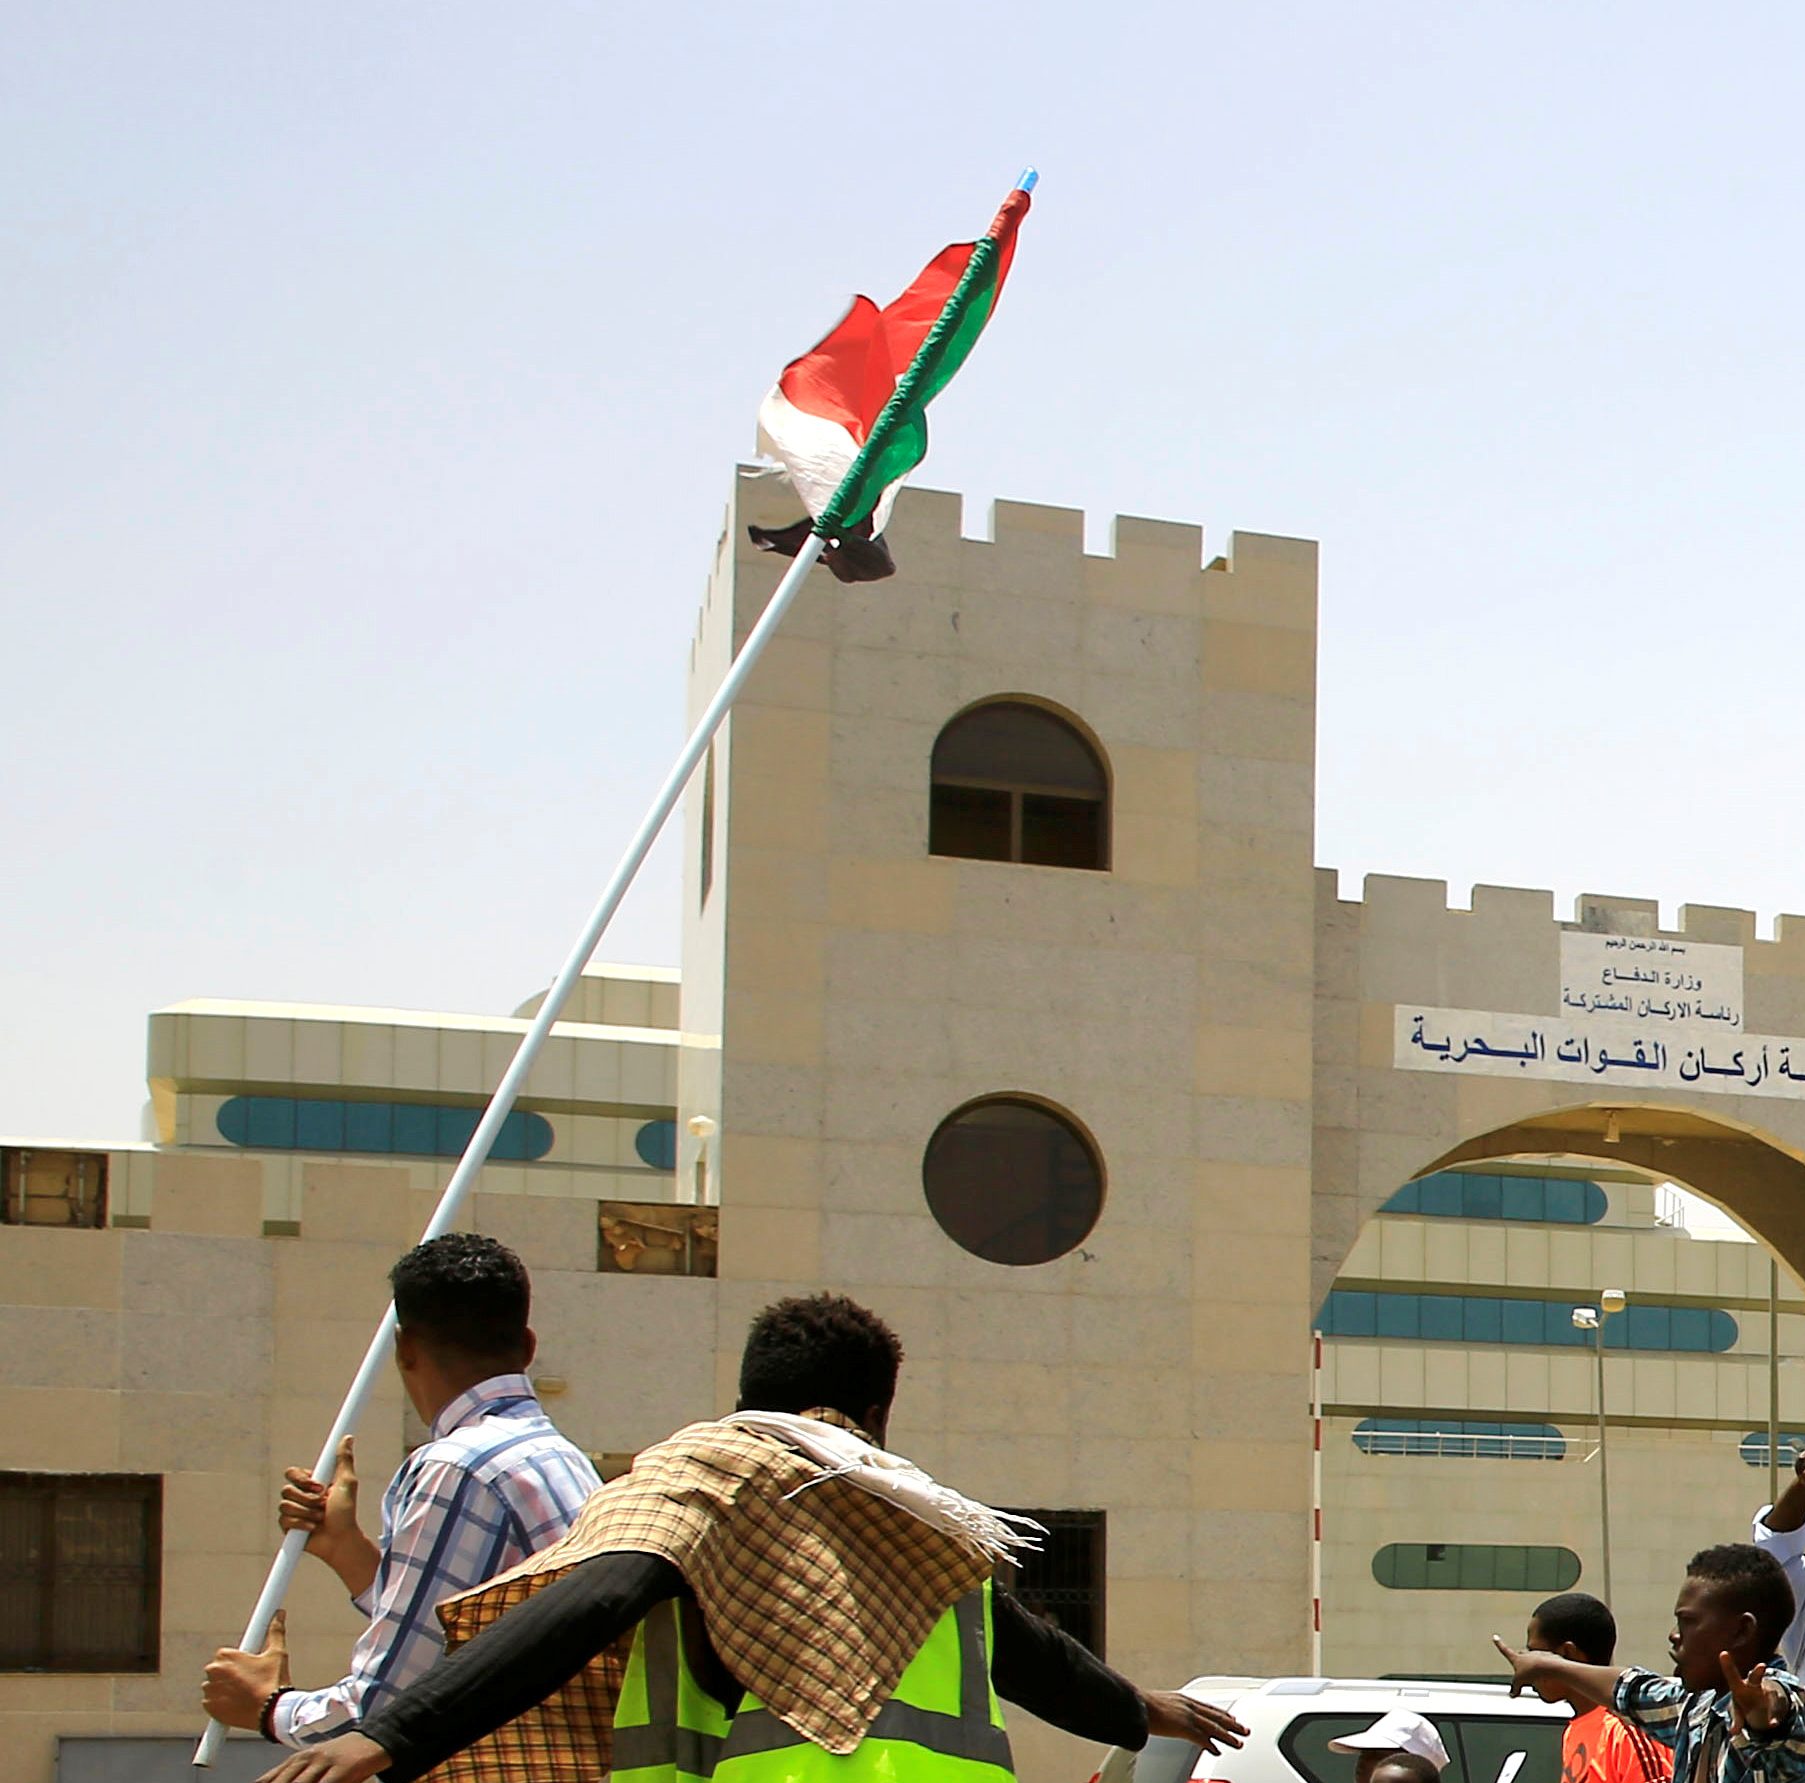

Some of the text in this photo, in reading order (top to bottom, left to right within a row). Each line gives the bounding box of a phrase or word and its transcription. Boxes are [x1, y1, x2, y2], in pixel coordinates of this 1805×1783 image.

[1658, 940, 1670, 951] الله
[1671, 946, 1686, 956] بسم
[1602, 966, 1703, 991] وزارة الدفاع
[1563, 988, 1632, 1012] المشتركة
[1411, 1015, 1545, 1067] البحرية
[1557, 1037, 1667, 1073] القوات
[1679, 1044, 1769, 1086] أركان
